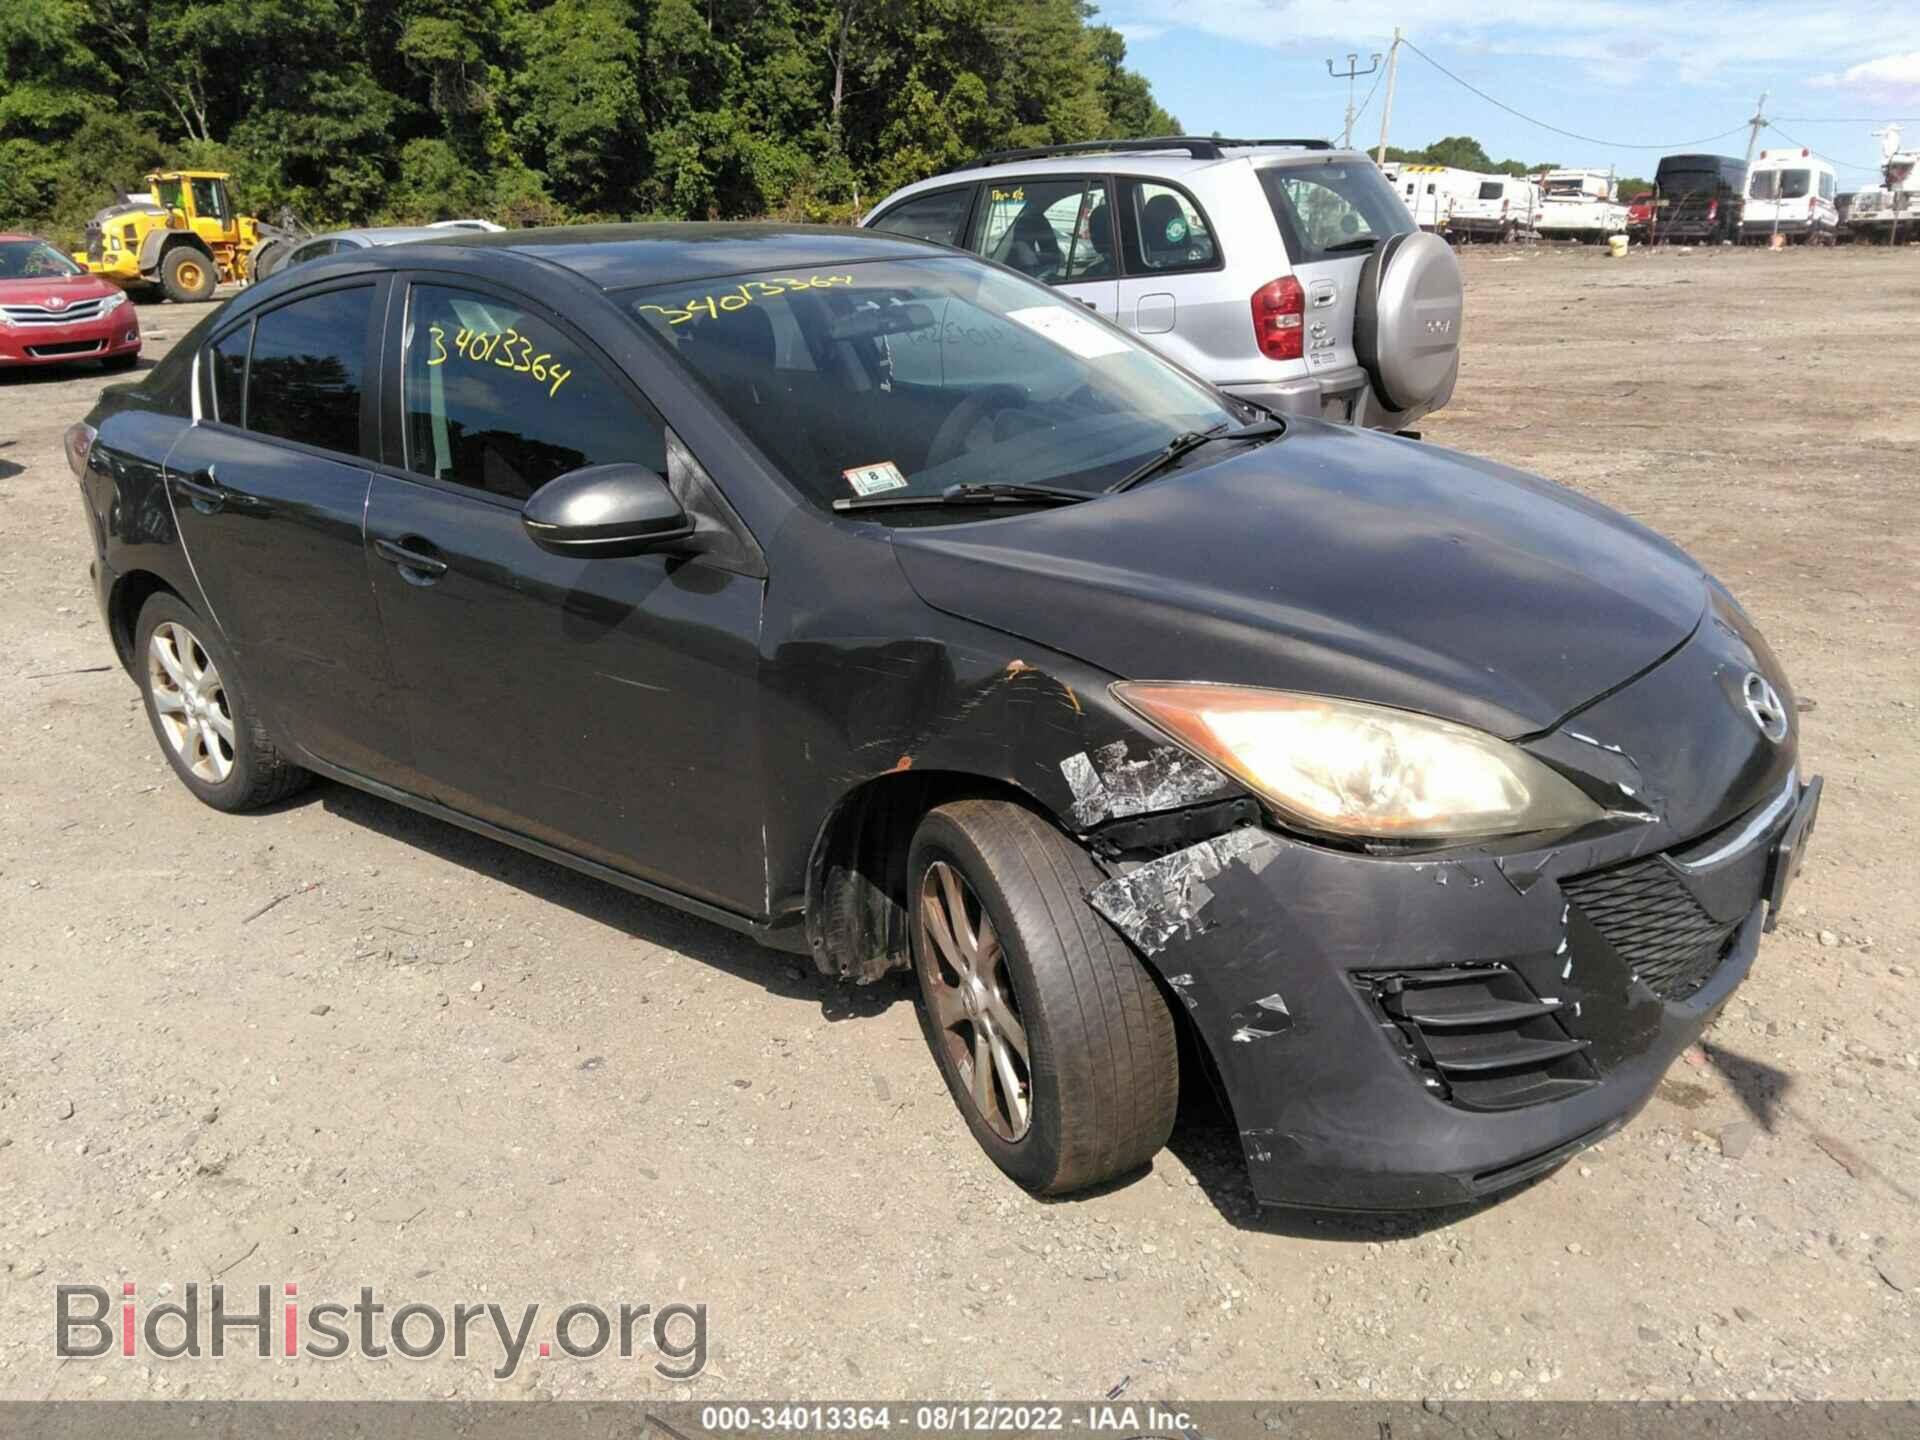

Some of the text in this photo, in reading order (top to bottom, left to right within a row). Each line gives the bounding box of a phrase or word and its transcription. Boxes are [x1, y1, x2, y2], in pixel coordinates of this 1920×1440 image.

[640, 275, 853, 325] 34013364
[427, 326, 572, 397] 34013364
[869, 471, 880, 481] 8
